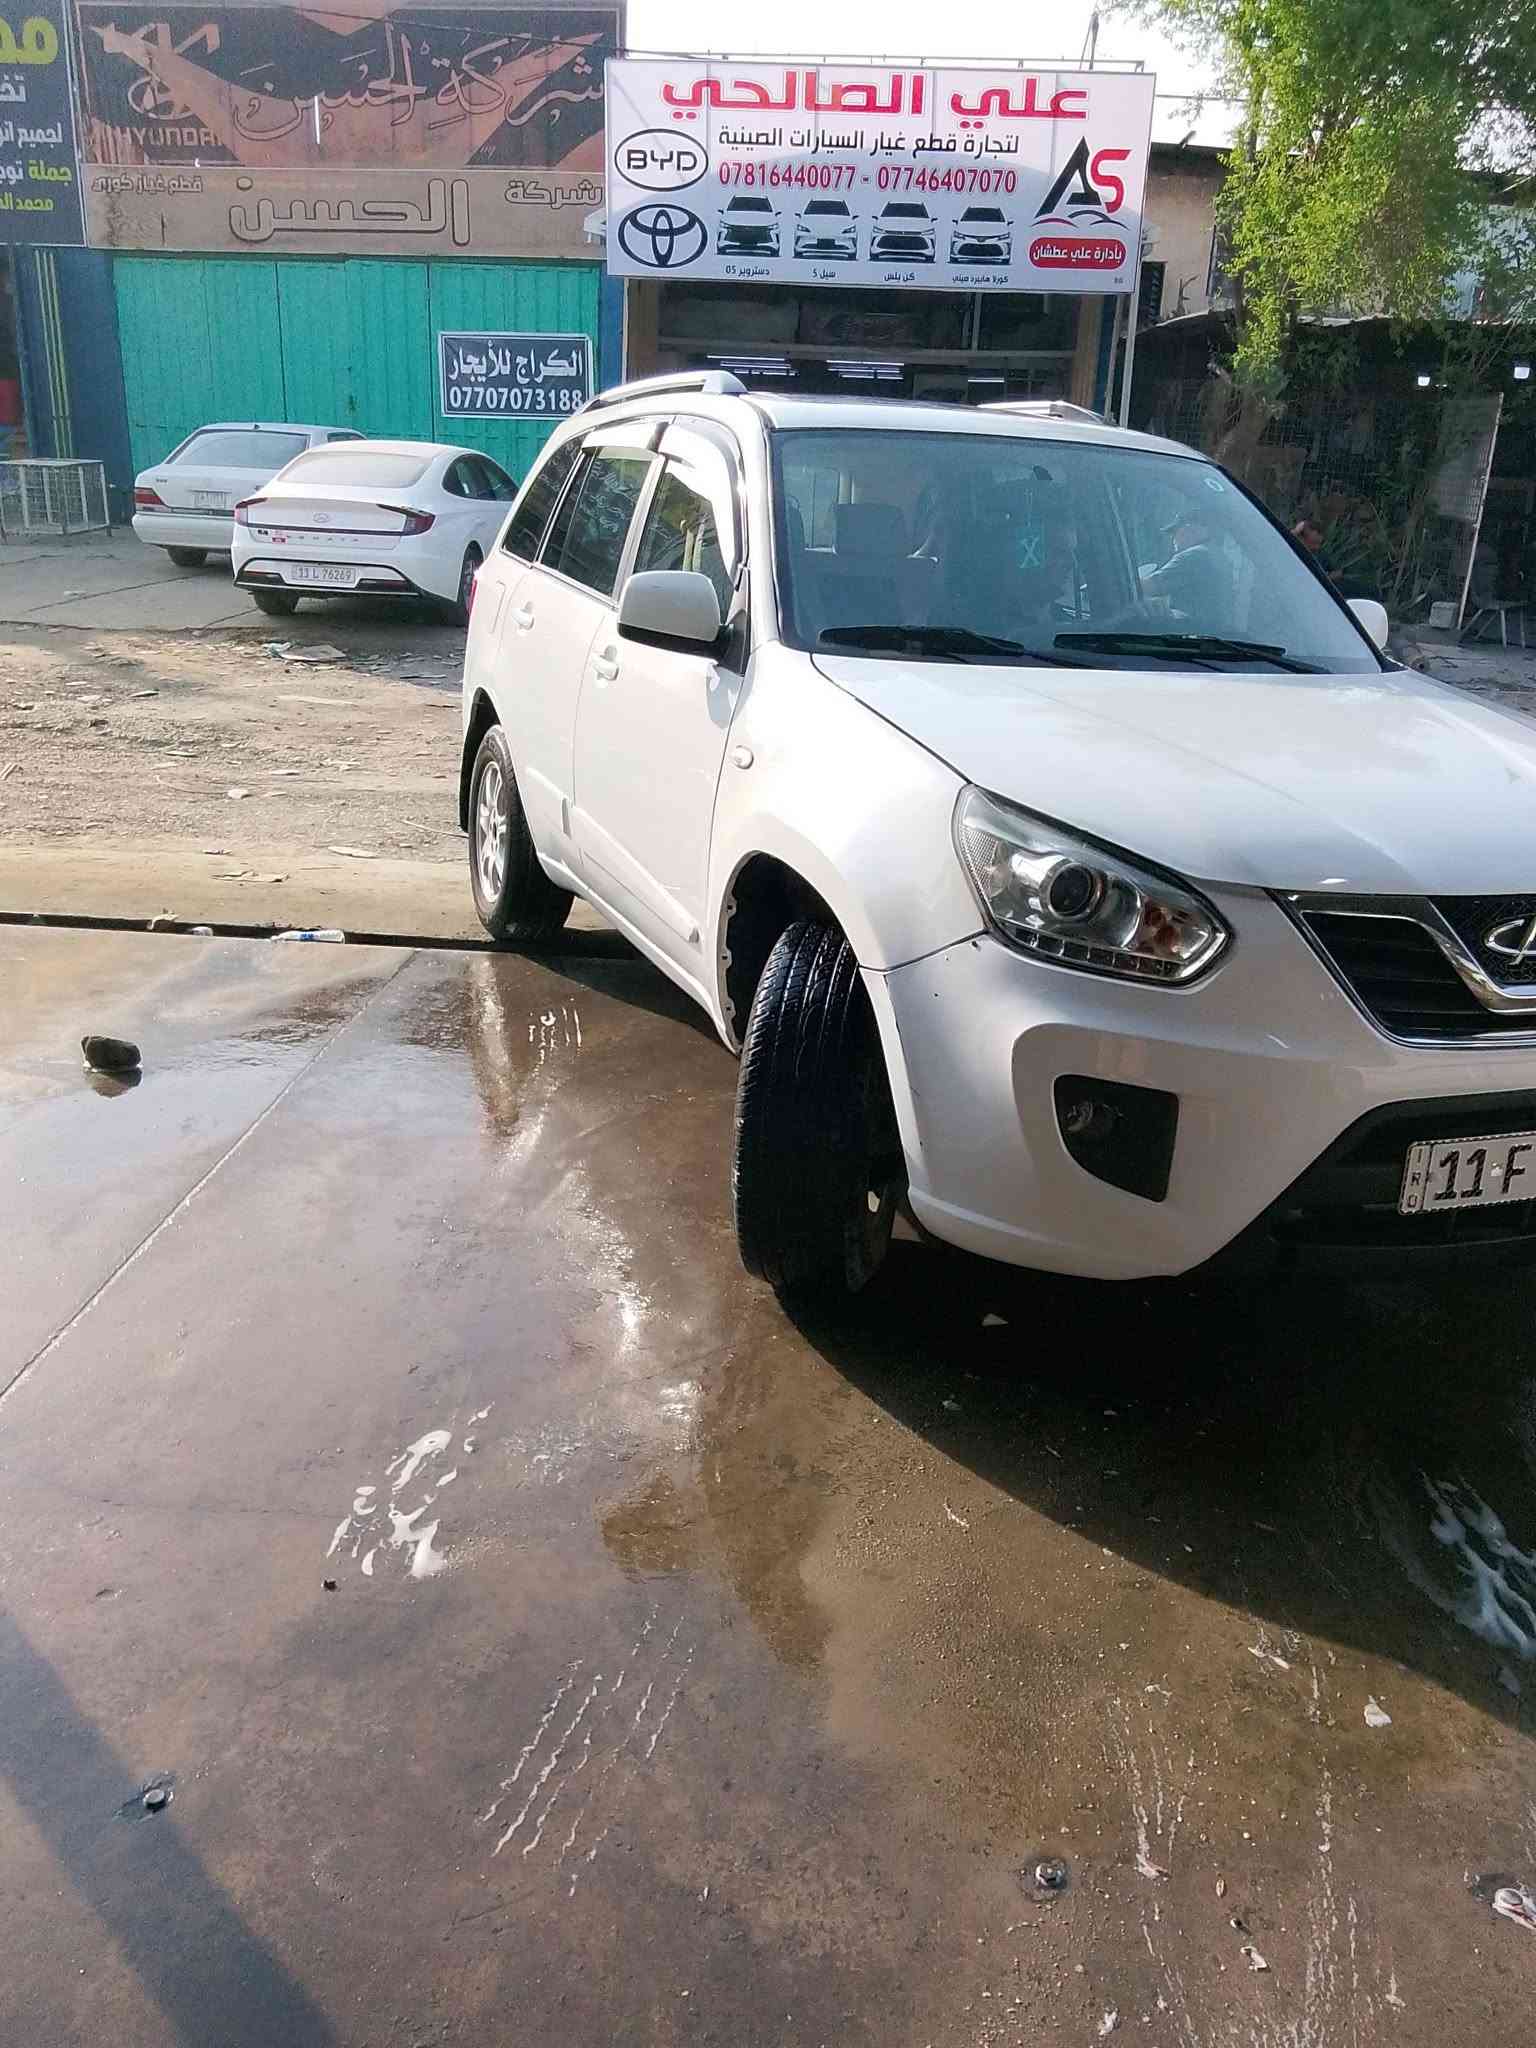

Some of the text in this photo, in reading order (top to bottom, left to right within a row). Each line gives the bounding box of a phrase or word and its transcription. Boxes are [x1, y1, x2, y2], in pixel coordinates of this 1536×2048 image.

[662, 71, 1087, 130] علي الصالحي
[17, 121, 63, 149] لجميع
[718, 124, 1019, 160] لتجارة قطع غيار السيارات الصينية
[28, 159, 73, 187] جملة
[627, 149, 698, 171] BYD
[718, 161, 857, 190] 07816440077
[877, 165, 1017, 193] 07746407070
[1034, 136, 1132, 218] AS
[503, 178, 604, 209] شركة
[228, 176, 472, 247] الحسن
[449, 339, 583, 384] الكراج للأيجار
[450, 386, 582, 411] 07707073188
[1434, 1144, 1533, 1201] 11 F
